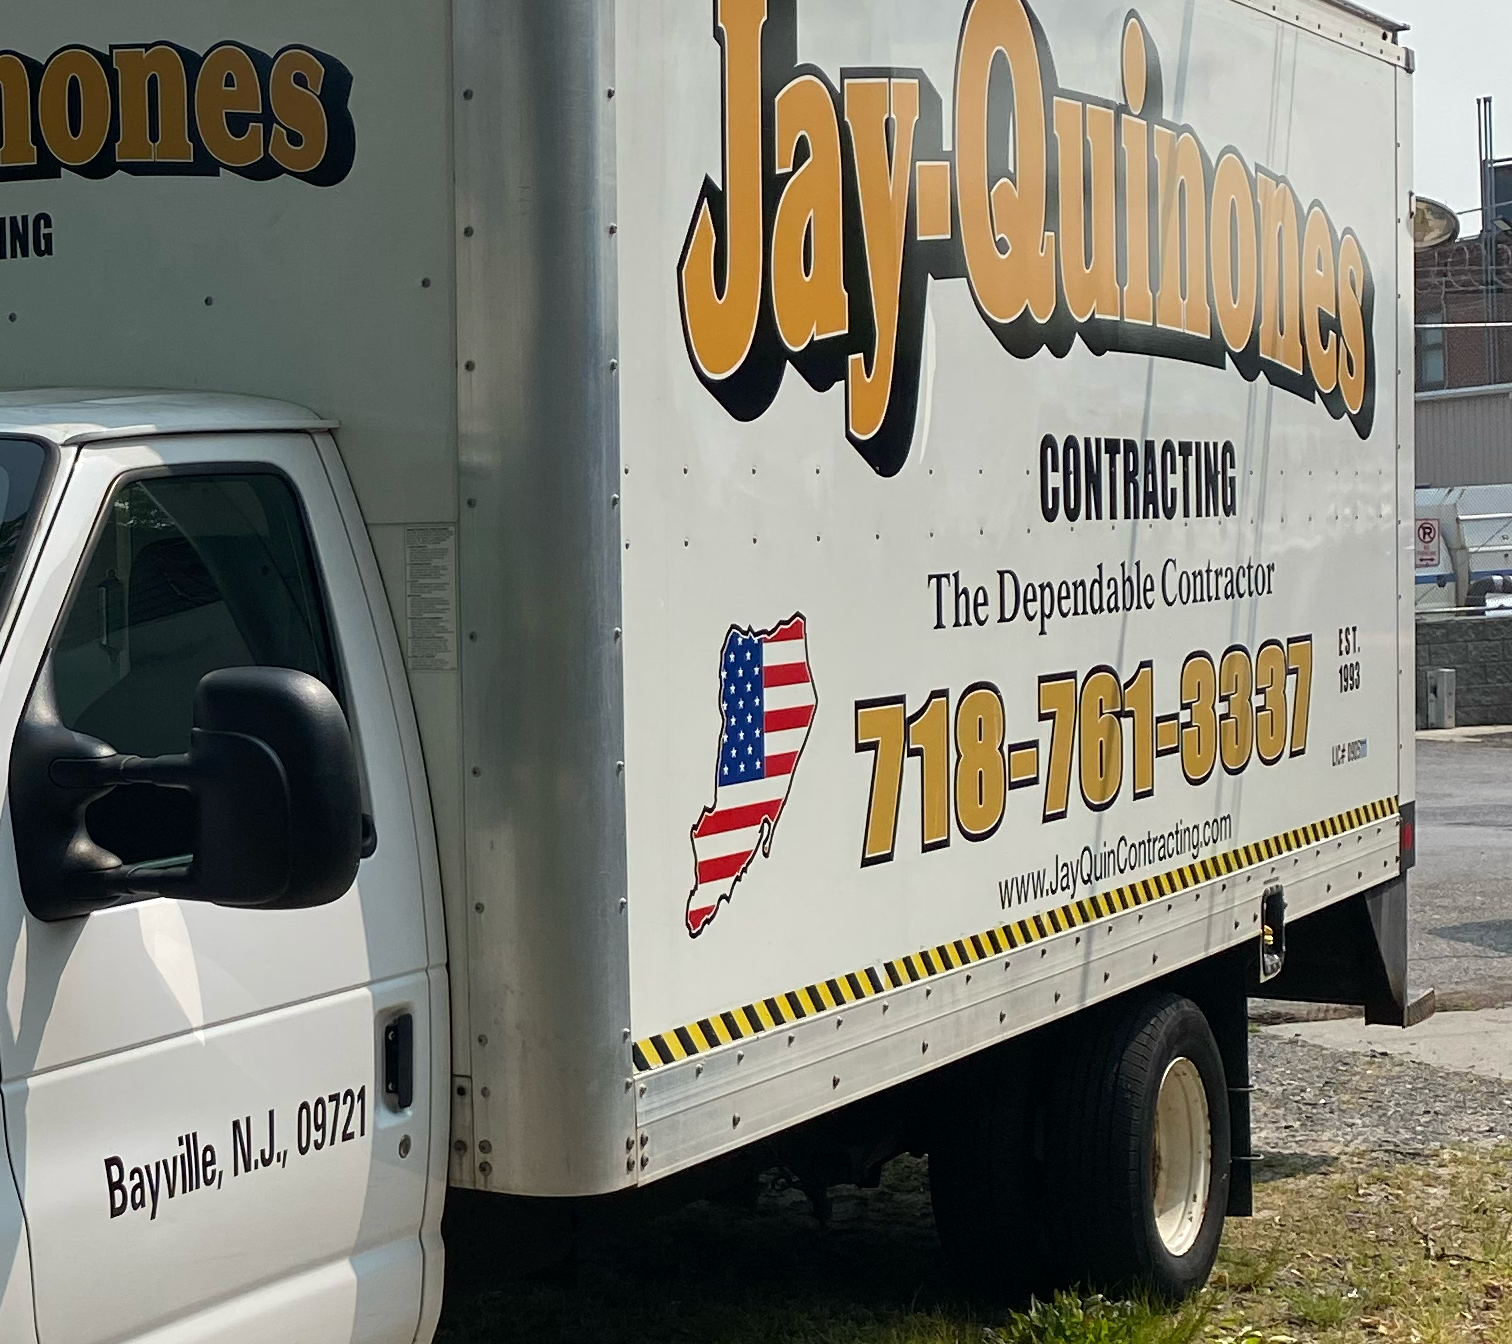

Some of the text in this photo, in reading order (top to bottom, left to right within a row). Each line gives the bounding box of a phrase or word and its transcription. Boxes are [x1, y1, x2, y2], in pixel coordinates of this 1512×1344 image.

[1039, 433, 1238, 523] CONTRACTING
[928, 556, 1276, 636] The Dependable Contractor
[1338, 625, 1361, 657] EST.
[1338, 660, 1361, 694] 1993
[854, 633, 1313, 868] 718-761-3337
[998, 812, 1233, 910] www.JayQuinContracting.com
[104, 1084, 368, 1221] Bayville, N.J., 09721
